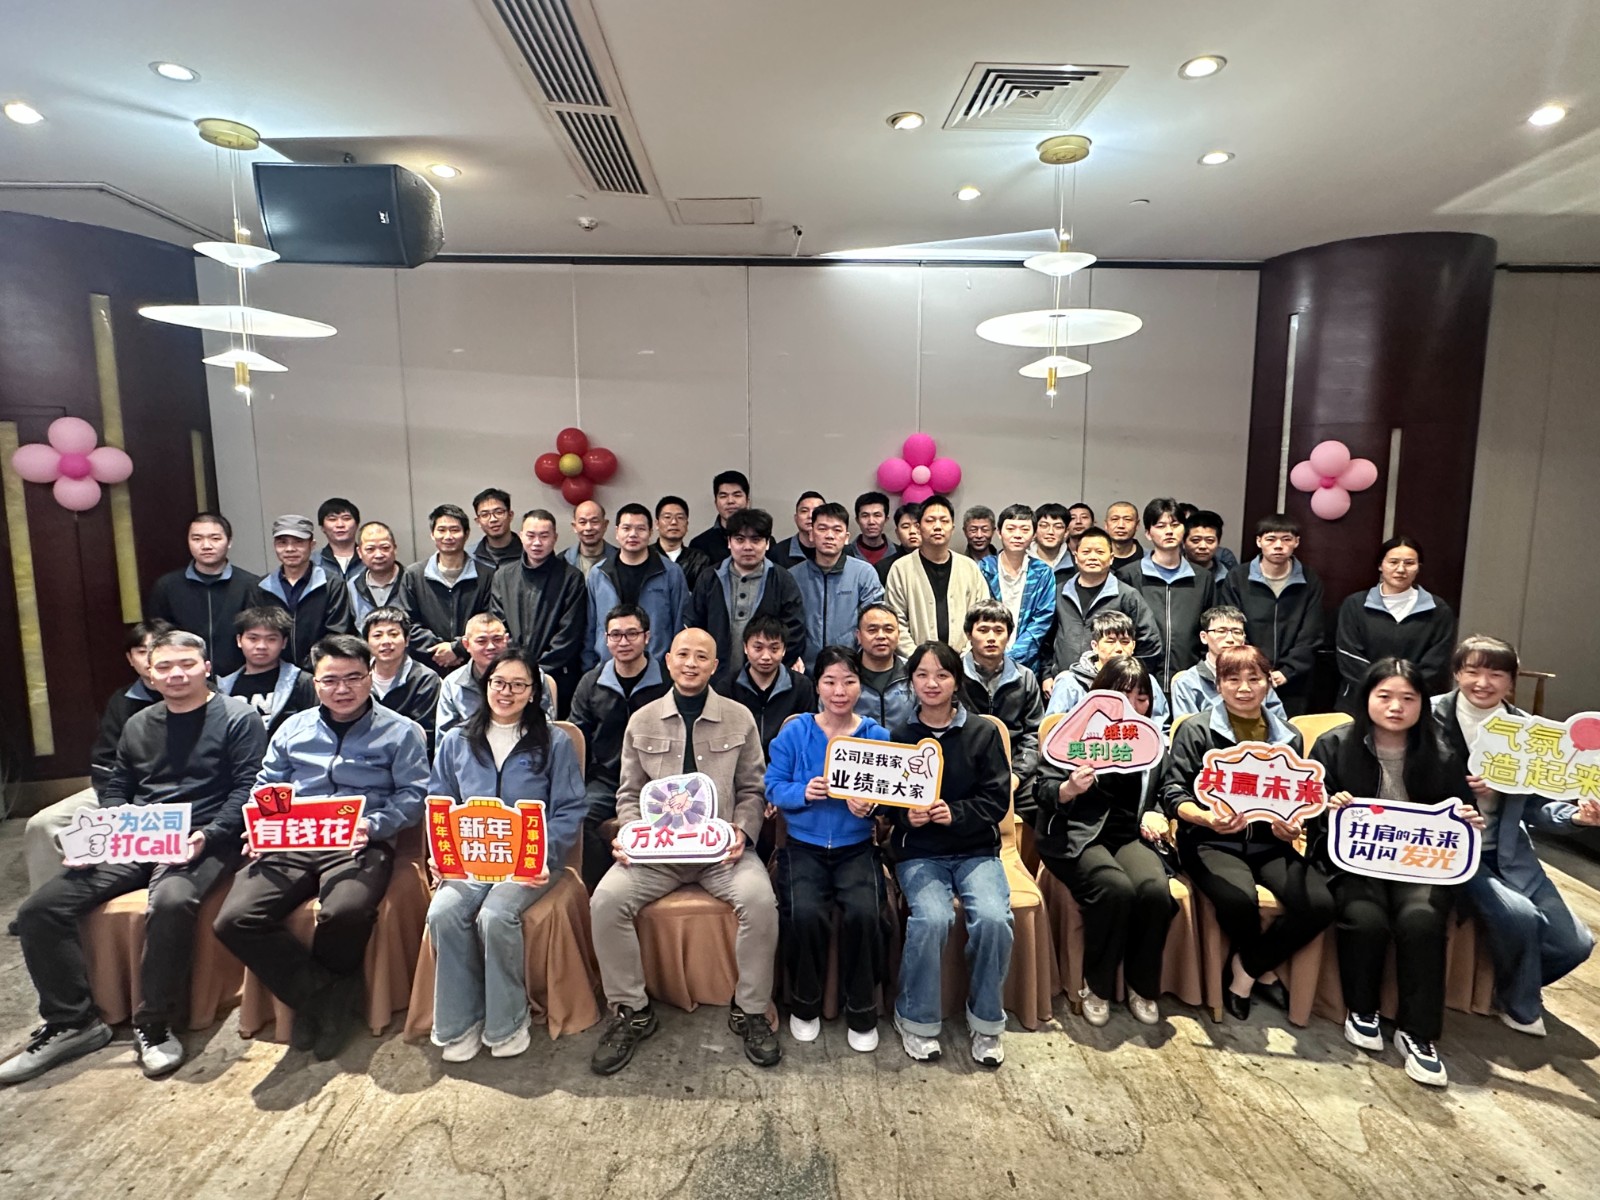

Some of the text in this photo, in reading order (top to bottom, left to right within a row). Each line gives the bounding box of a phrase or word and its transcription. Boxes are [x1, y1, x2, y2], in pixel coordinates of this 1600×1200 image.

[1104, 724, 1140, 741] 继续
[1483, 716, 1567, 760] 气氛
[834, 748, 903, 769] 公司是我家
[1066, 741, 1134, 762] 奥利给
[830, 769, 925, 799] 业绩靠大家
[1198, 768, 1324, 805] 共赢未来
[1480, 751, 1600, 799] 造起来
[118, 811, 183, 832] 为公司
[253, 819, 351, 846] 有钱花
[458, 816, 513, 840] 新年
[1348, 821, 1461, 849] 并肩的未来
[432, 811, 456, 867] 新年快乐
[523, 815, 540, 869] 万事如意
[631, 825, 723, 850] 万众一心
[460, 840, 515, 864] 快乐
[1348, 840, 1458, 871] 闪闪发光
